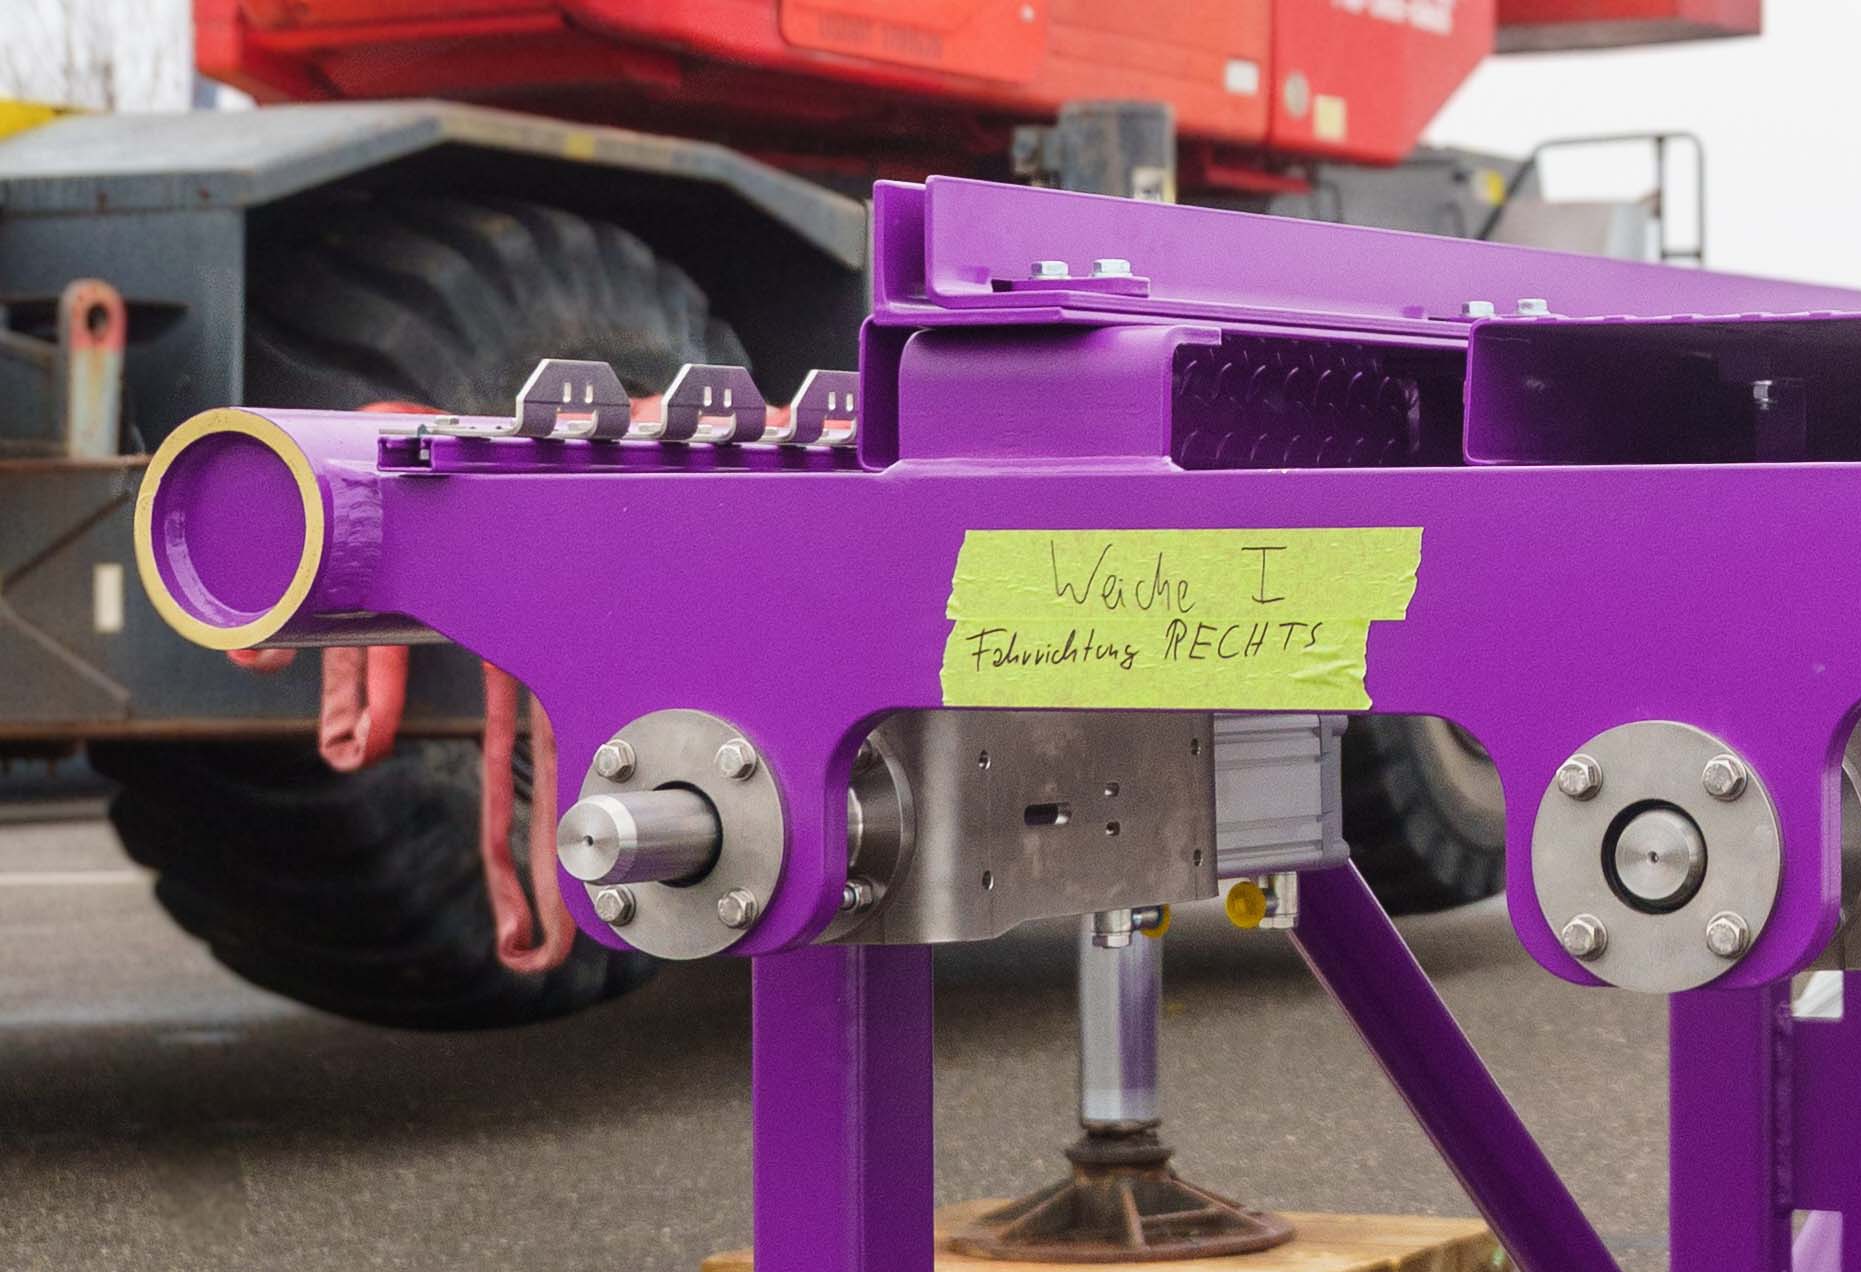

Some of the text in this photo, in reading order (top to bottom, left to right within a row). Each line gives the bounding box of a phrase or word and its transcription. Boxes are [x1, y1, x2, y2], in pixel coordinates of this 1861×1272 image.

[1050, 539, 1288, 614] Weiche I
[965, 617, 1325, 673] Fahrrichtung RECHTS
